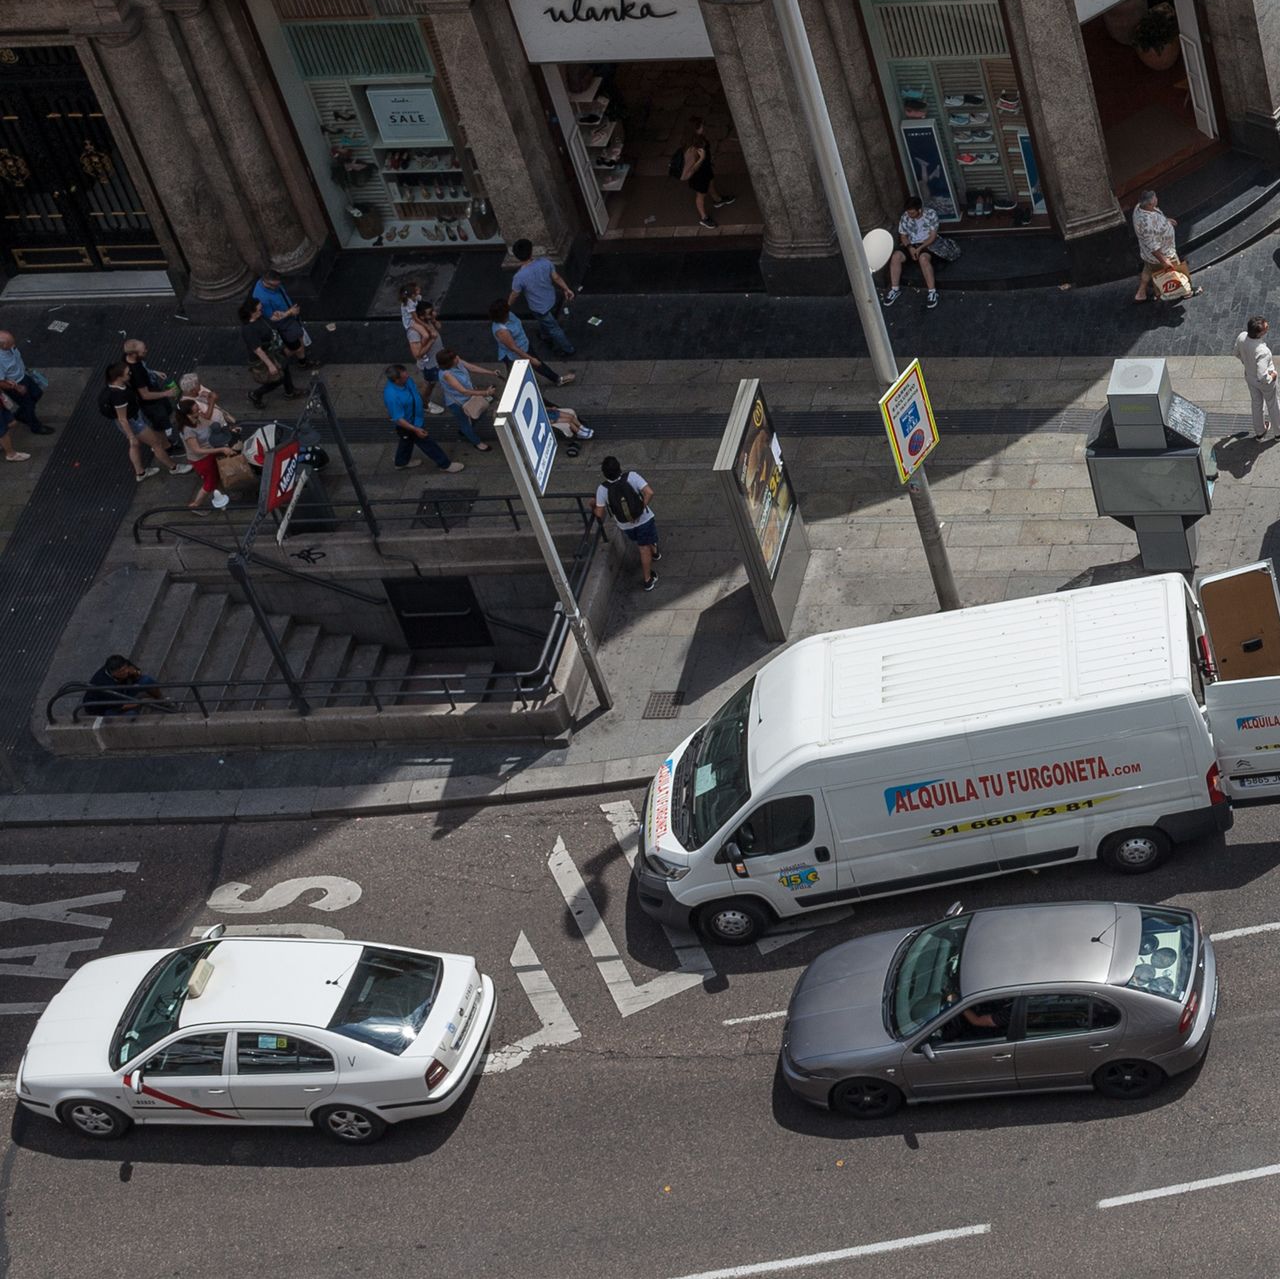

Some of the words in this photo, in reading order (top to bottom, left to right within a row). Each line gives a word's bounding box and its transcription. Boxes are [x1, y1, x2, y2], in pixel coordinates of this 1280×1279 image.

[389, 114, 425, 123] SALE
[514, 381, 539, 471] P
[1241, 715, 1280, 730] ALQUILA
[895, 778, 980, 814] ALQUILA
[979, 773, 1004, 799] TU
[930, 824, 959, 838] 91
[970, 814, 1018, 830] 660
[1025, 807, 1057, 820] 73
[1065, 799, 1094, 811] 81
[778, 873, 802, 887] 15
